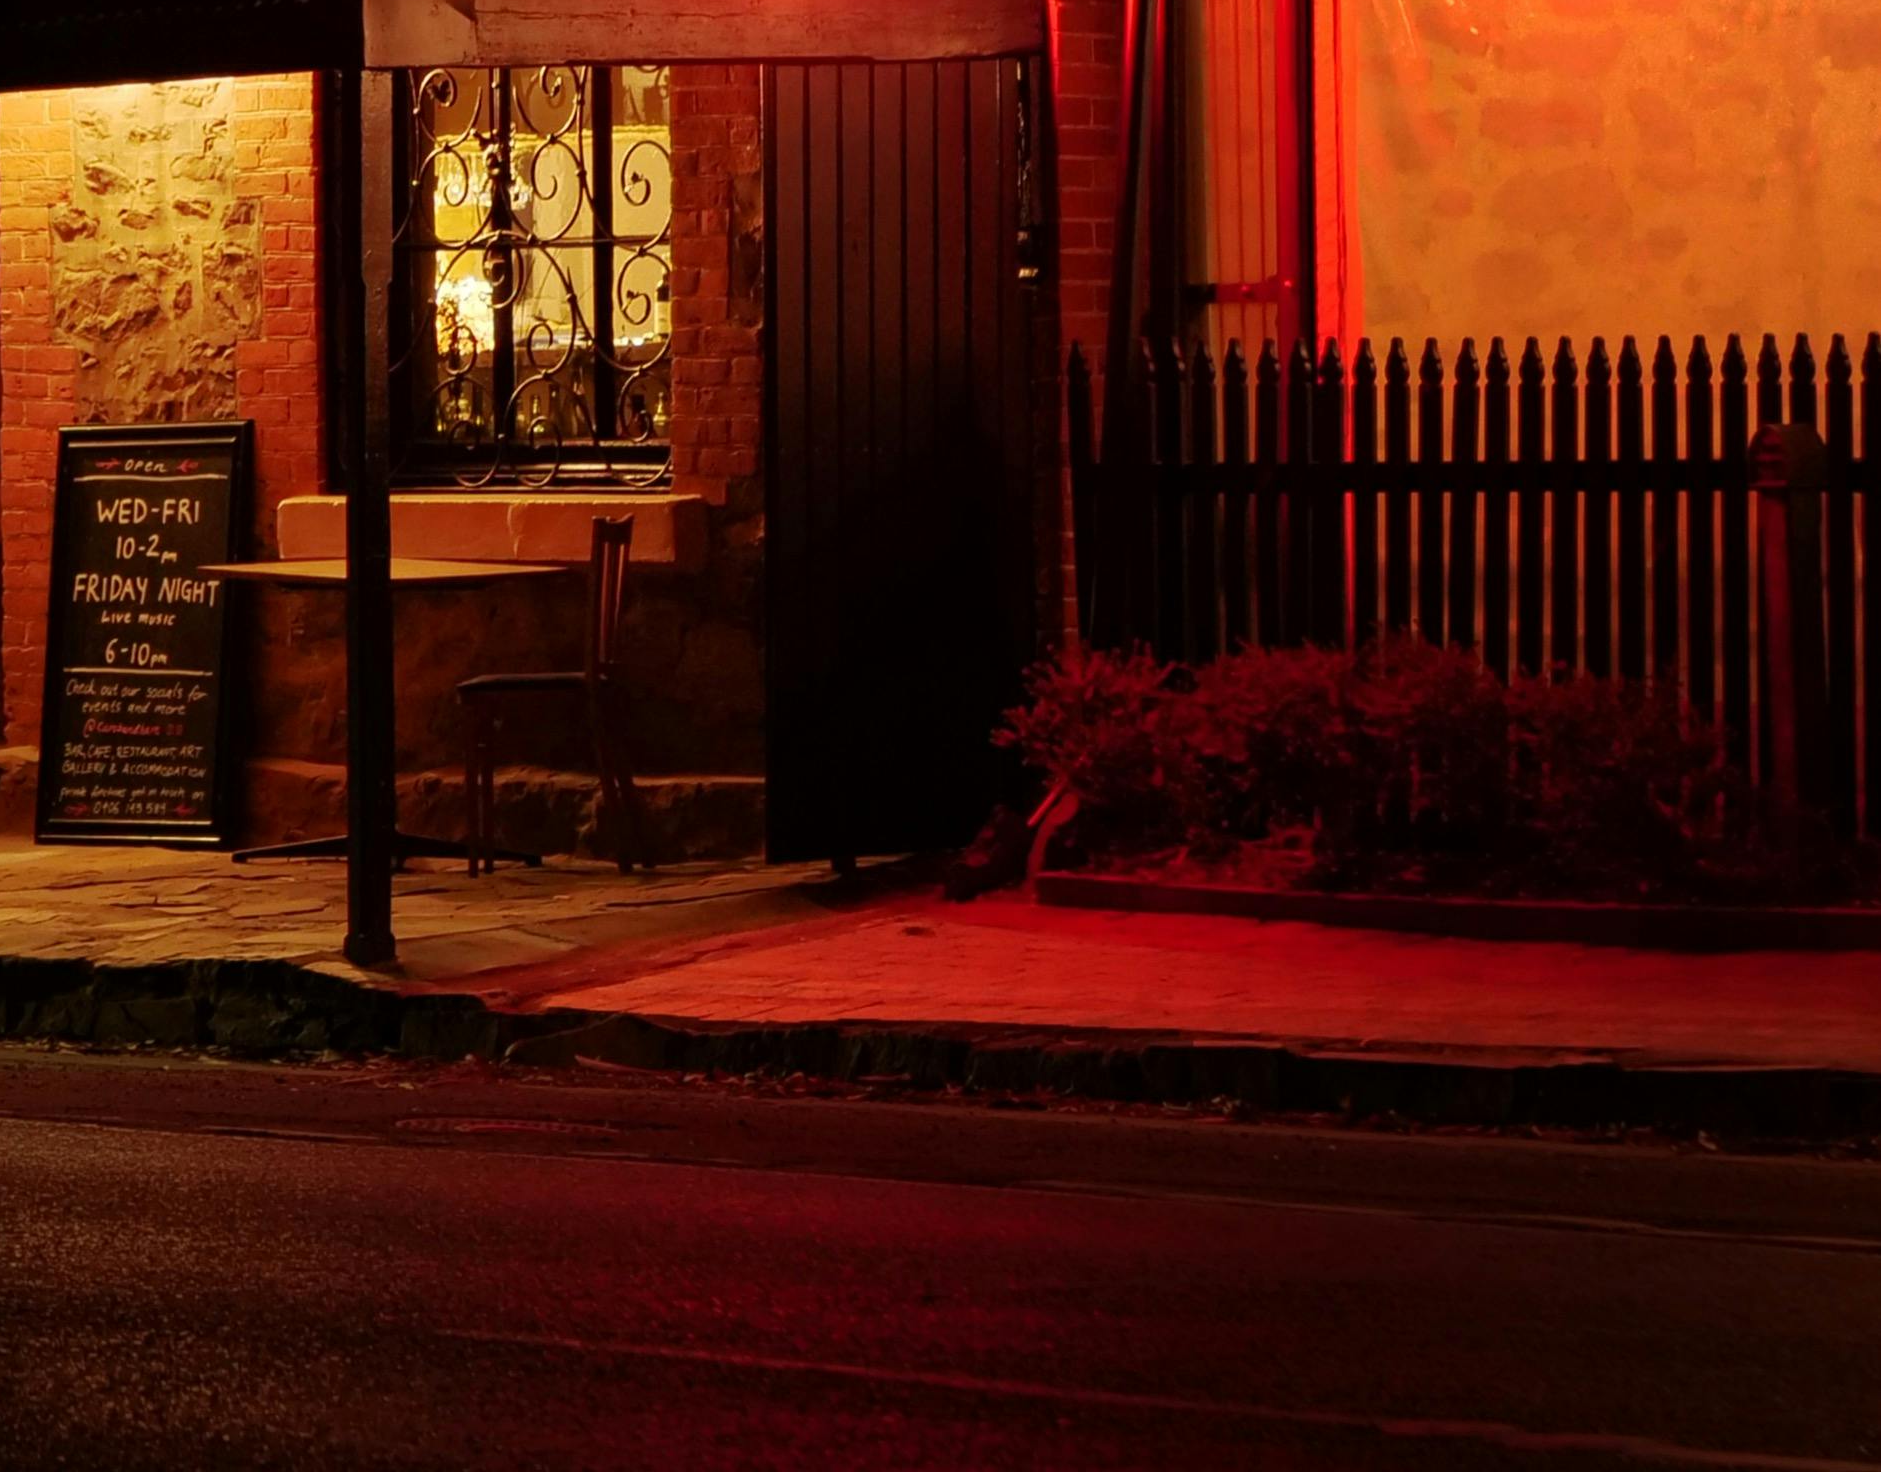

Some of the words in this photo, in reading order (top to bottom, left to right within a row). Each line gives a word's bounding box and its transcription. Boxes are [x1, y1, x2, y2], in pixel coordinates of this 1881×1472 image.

[96, 498, 200, 525] WED-FRI
[73, 573, 148, 605] FRIDAY
[158, 577, 220, 607] NIGHT
[66, 679, 97, 697] Check
[100, 685, 118, 696] out
[120, 688, 142, 699] our
[146, 682, 183, 700] socials
[187, 685, 208, 703] for
[82, 701, 121, 714] events
[127, 702, 148, 714] and
[154, 705, 186, 715] more
[180, 745, 204, 759] ART
[62, 760, 106, 776] GALLERY
